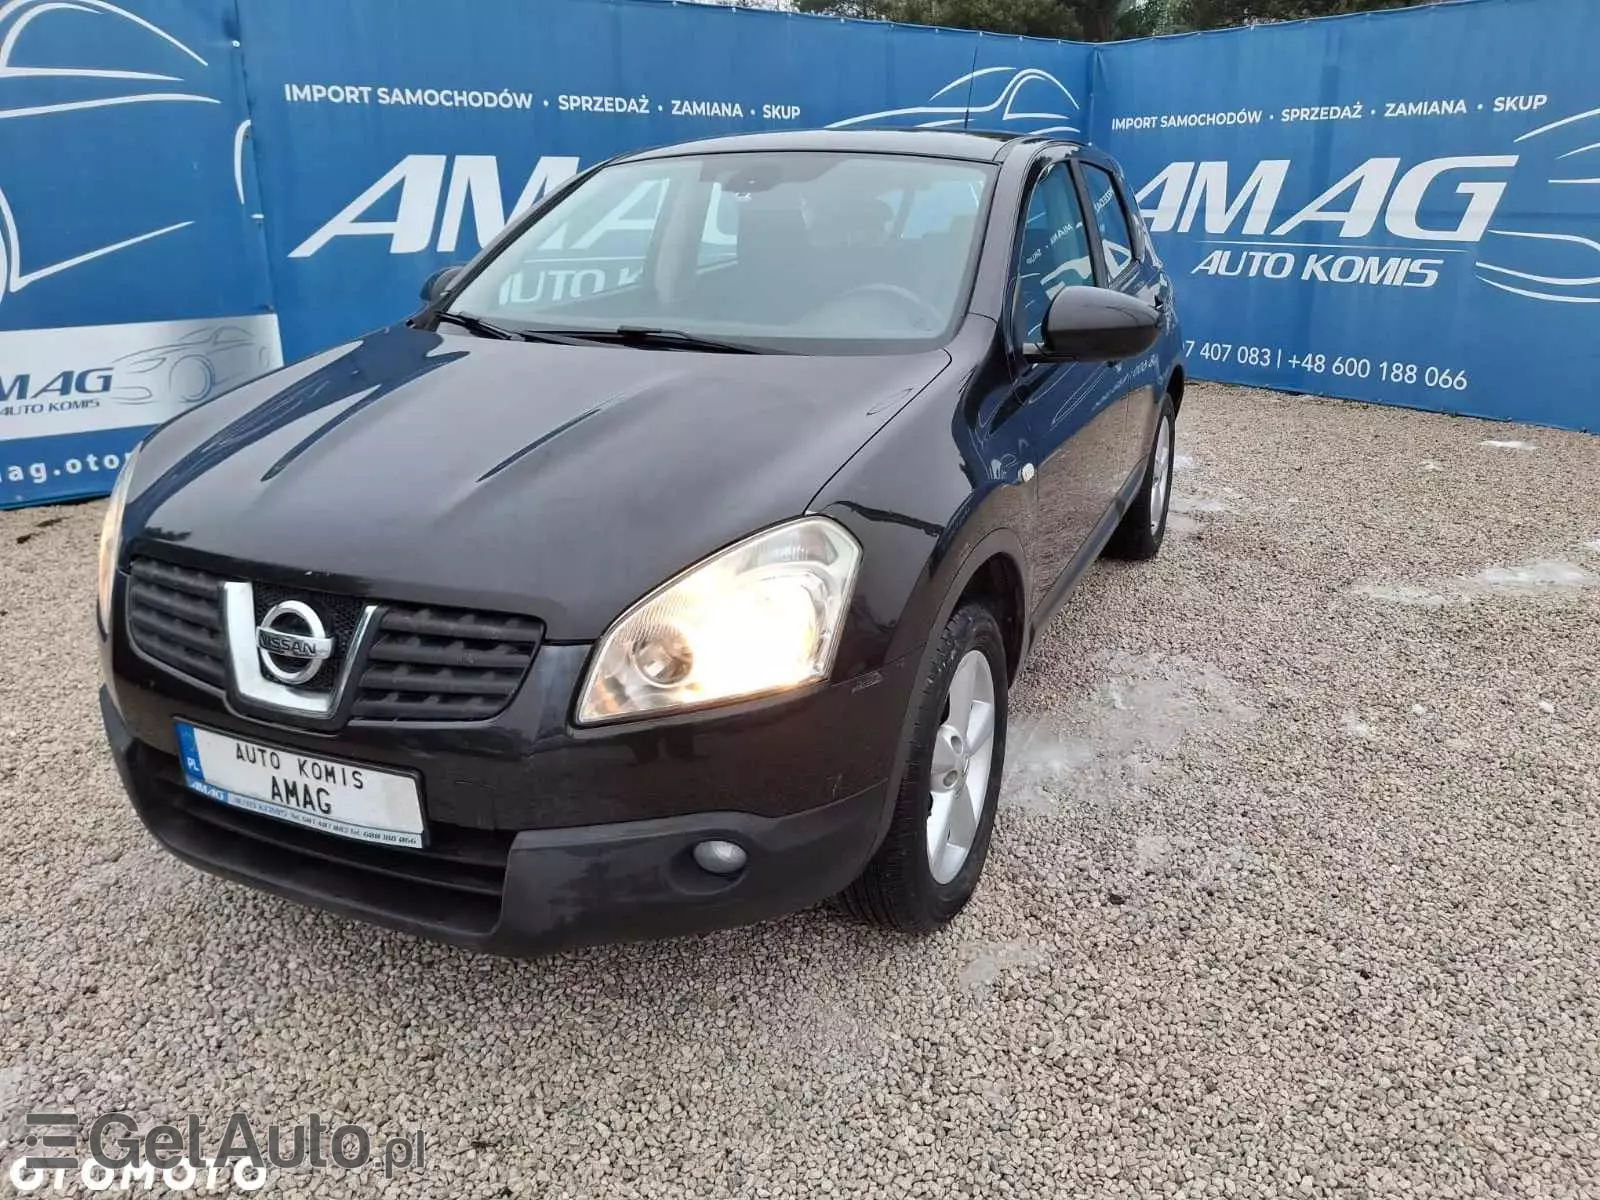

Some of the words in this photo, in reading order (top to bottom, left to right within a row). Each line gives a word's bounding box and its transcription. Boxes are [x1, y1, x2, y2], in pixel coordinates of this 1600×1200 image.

[284, 83, 372, 104] IMPORT
[376, 87, 533, 109] SAMOCHODÓW
[558, 94, 650, 114] SPRZEDAŻ
[671, 100, 744, 118] ZAMIANA
[762, 104, 801, 120] SKUP
[1111, 115, 1158, 130] IMPORT
[1160, 108, 1263, 128] SAMOCHODÓW
[1280, 101, 1363, 122] SPRZEDAŻ
[1384, 99, 1467, 117] ZAMIANA
[1492, 94, 1548, 112] SKUP
[1190, 249, 1296, 279] AUTO
[1300, 253, 1444, 288] KOMIS
[1199, 342, 1232, 361] 407
[1237, 346, 1271, 367] 083
[1288, 353, 1325, 373] +48
[1332, 357, 1371, 378] 600
[1379, 361, 1417, 384] 188
[1424, 366, 1468, 390] 066
[49, 399, 101, 413] KOMIS
[260, 633, 317, 655] NISSAN
[187, 756, 200, 771] PL
[236, 743, 281, 770] AUTO
[299, 757, 364, 790] KOMIS
[270, 775, 332, 815] AMAG
